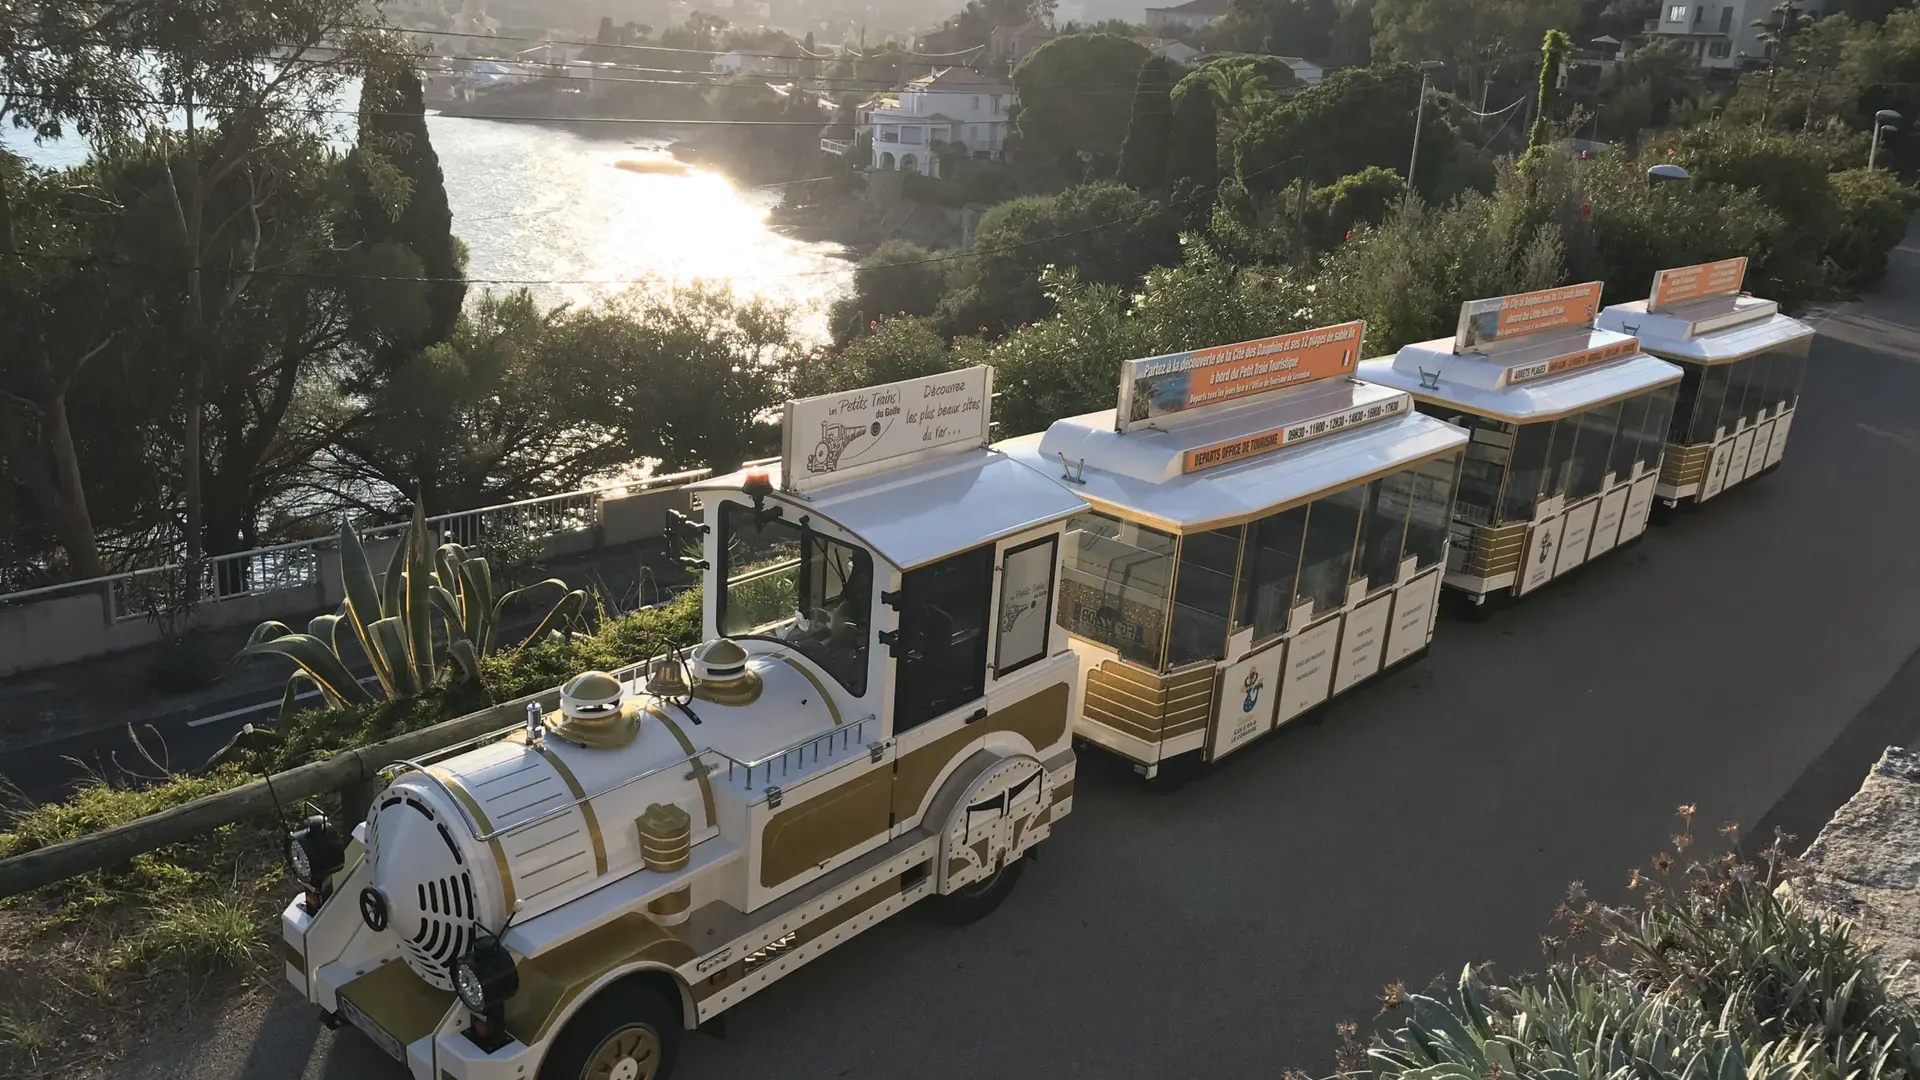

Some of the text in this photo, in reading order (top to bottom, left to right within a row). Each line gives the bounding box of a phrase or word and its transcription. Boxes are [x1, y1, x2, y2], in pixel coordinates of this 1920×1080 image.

[1144, 362, 1165, 378] Partez
[1165, 364, 1171, 373] à
[1172, 360, 1180, 372] la
[1180, 353, 1216, 372] découverte
[1216, 351, 1225, 364] de
[1225, 350, 1232, 362] la
[1232, 346, 1244, 360] Cité
[1245, 345, 1256, 358] des
[1256, 340, 1284, 357] Dauphins
[1284, 338, 1290, 351] et
[1291, 339, 1300, 349] ses
[1300, 336, 1309, 348] 12
[1308, 334, 1326, 349] plages
[1327, 332, 1335, 343] de
[1335, 328, 1347, 341] sable
[1215, 368, 1230, 384] bord
[1231, 367, 1238, 380] du
[1239, 362, 1254, 378] Petit
[1254, 361, 1268, 375] Train
[1269, 356, 1299, 372] Touristique
[1530, 364, 1546, 376] PLAGES
[828, 388, 897, 416] Les Petits Trains
[924, 382, 966, 400] Découvrez
[876, 406, 901, 419] du Golfe
[906, 396, 981, 424] les plus beaux sites
[1288, 426, 1305, 441] 09H30
[1309, 421, 1325, 435] 11H00
[1329, 416, 1345, 430] 12H30
[1348, 411, 1364, 424] 14H30
[1367, 406, 1382, 419] 16H00
[1385, 401, 1399, 413] 17H30
[922, 428, 933, 442] du
[1194, 433, 1278, 466] DEPARTS OFFICE DE TOURISME
